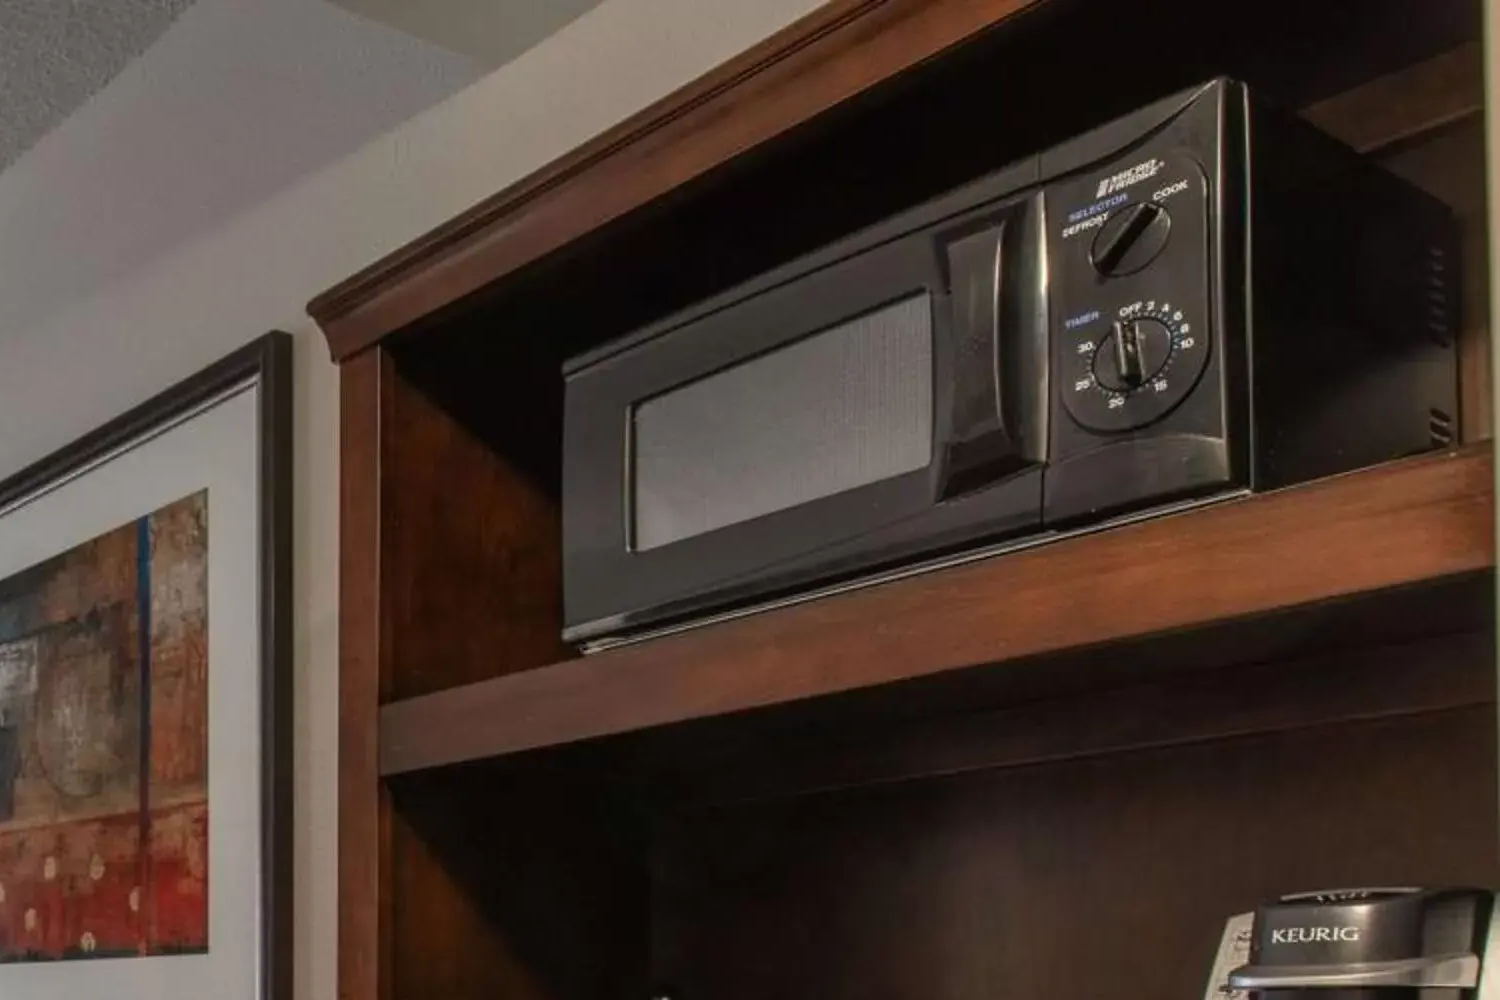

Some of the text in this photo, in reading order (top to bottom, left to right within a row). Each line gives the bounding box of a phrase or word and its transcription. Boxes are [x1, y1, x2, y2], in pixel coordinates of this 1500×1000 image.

[1152, 180, 1188, 200] COOK
[1119, 301, 1142, 317] OFF
[1065, 311, 1099, 330] TIMER
[1181, 337, 1195, 349] 10
[1271, 927, 1361, 944] KEURIG
